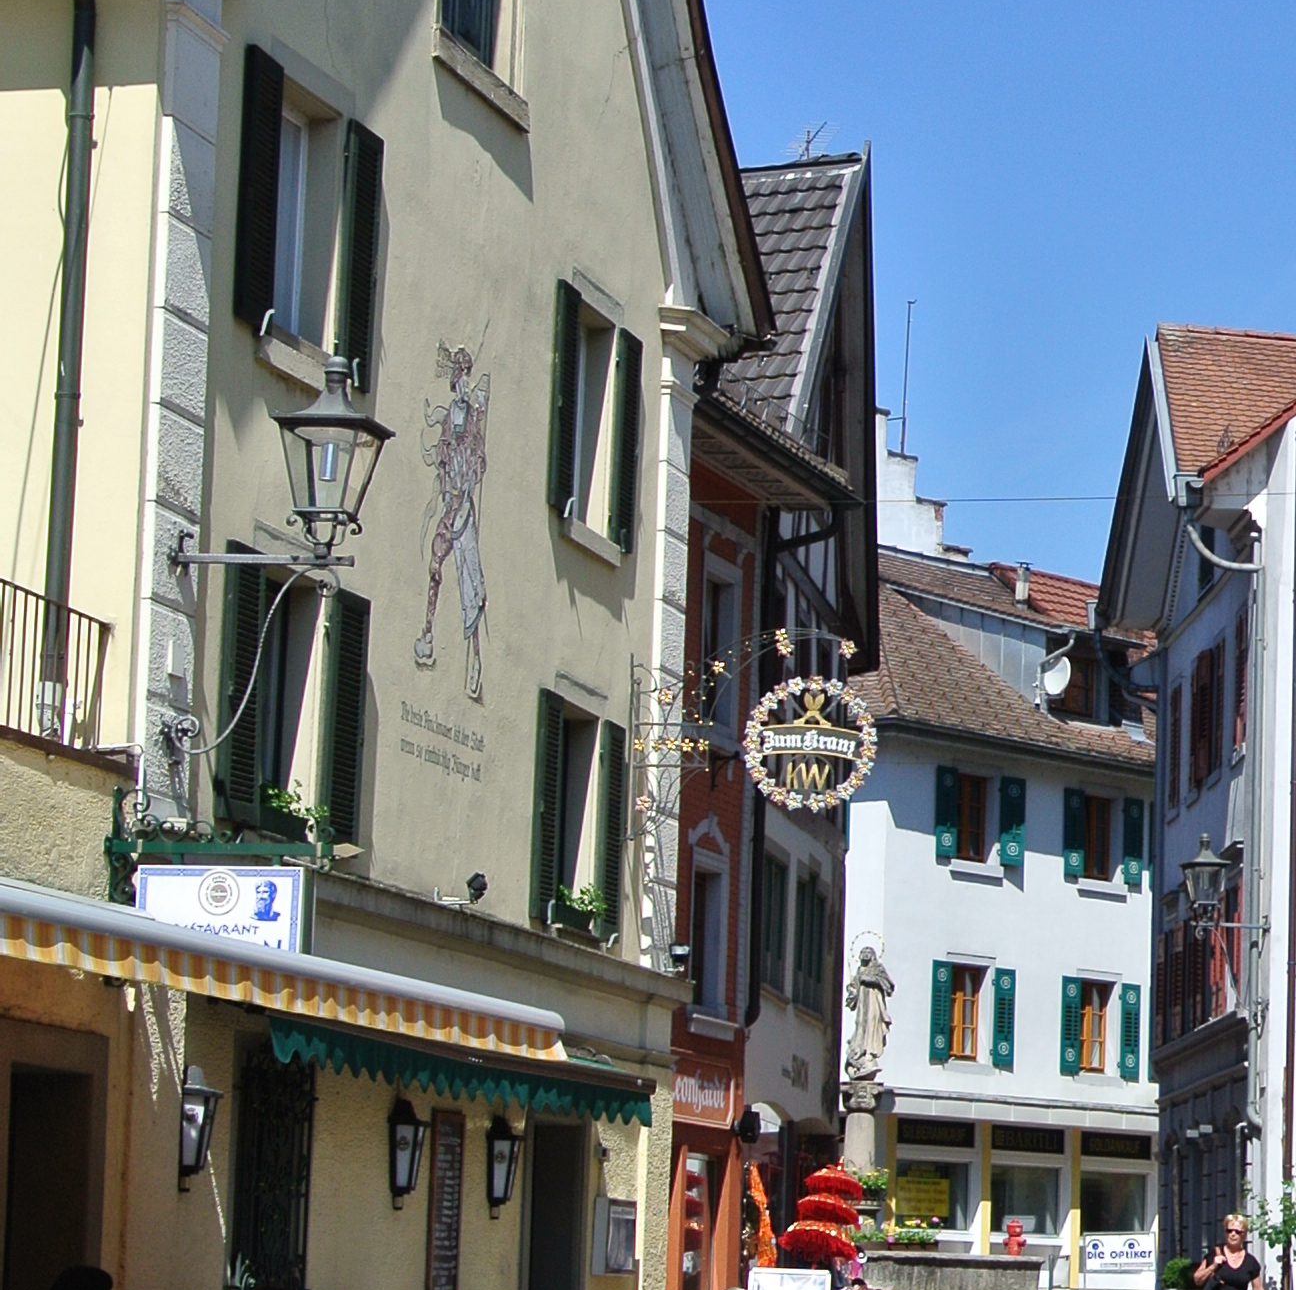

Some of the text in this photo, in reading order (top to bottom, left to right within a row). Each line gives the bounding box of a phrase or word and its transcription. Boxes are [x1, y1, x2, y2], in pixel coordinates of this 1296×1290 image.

[762, 729, 856, 758] Zum Kranz
[785, 761, 830, 790] KW
[174, 922, 260, 936] STAURANT
